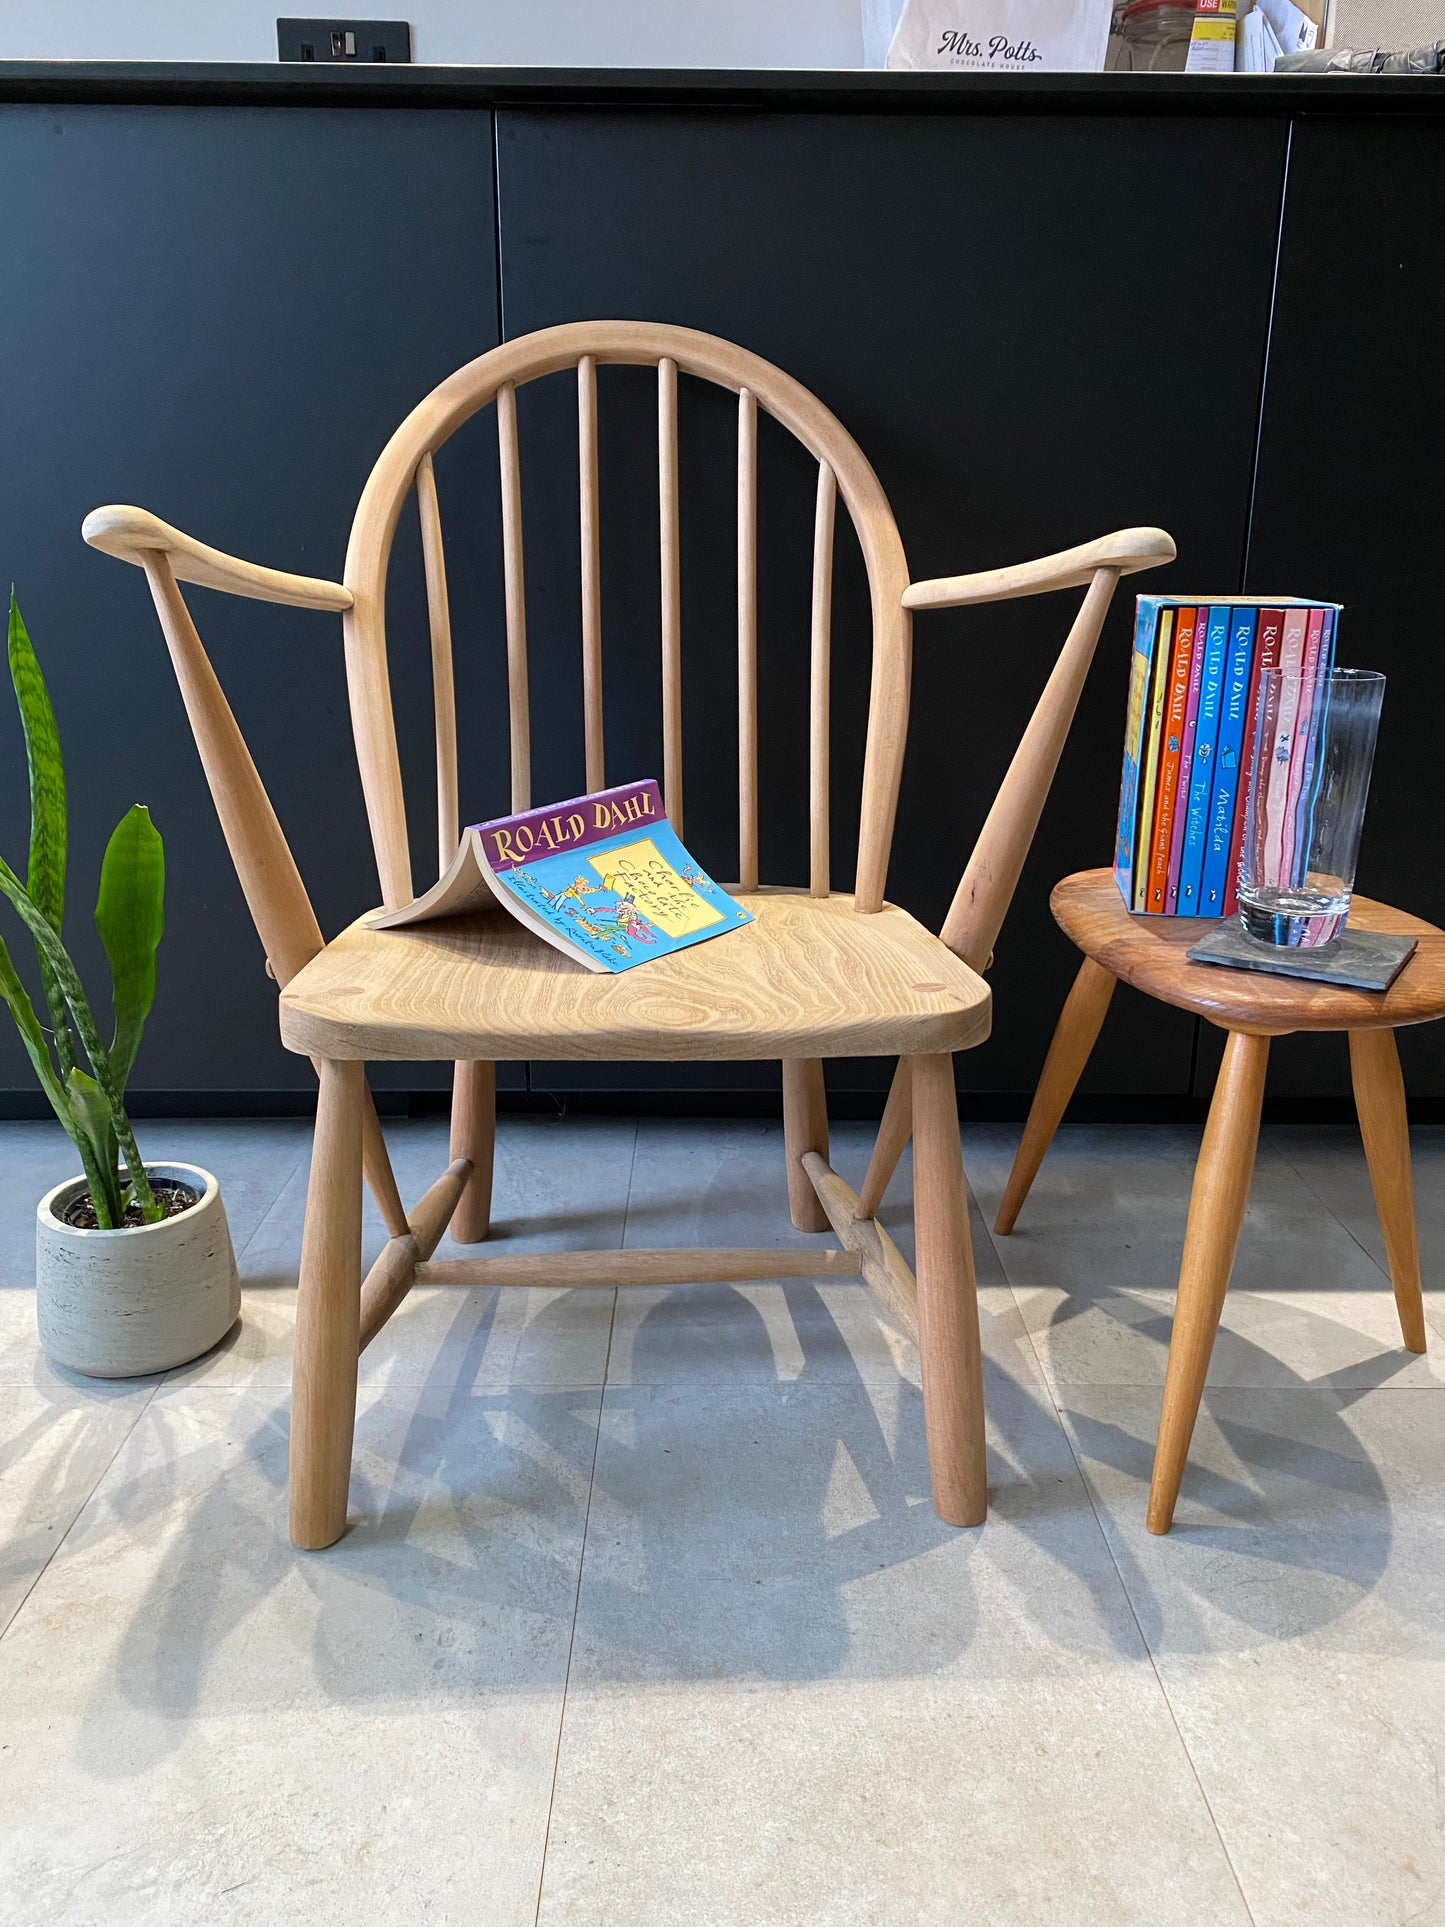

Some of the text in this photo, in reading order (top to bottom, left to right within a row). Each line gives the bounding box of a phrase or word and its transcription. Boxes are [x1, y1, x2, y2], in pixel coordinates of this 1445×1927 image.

[1200, 0, 1218, 8] USE
[937, 30, 1042, 61] Mrs. Potts
[950, 58, 995, 68] CHOCOLATE
[1193, 623, 1206, 693] ROALD DAHL
[1234, 626, 1251, 676] ROALD
[1309, 629, 1320, 664] ROALD
[1322, 629, 1331, 660] ROALD
[1171, 628, 1193, 721] ROALD DAHL
[1203, 625, 1225, 719] ROALD DAHL
[1228, 681, 1244, 720] DAHL
[1184, 753, 1192, 769] The
[491, 813, 585, 862] ROALD
[593, 791, 656, 831] DAHL
[1156, 761, 1175, 875] James and the Giant Peach
[1188, 781, 1208, 847] The Witches
[1213, 788, 1231, 852] Matilda
[613, 870, 670, 918] Factory
[618, 859, 684, 919] Chocolate
[642, 869, 688, 910] and the
[648, 860, 700, 909] Charlie
[508, 876, 620, 968] Illustrated by Quentin Blake
